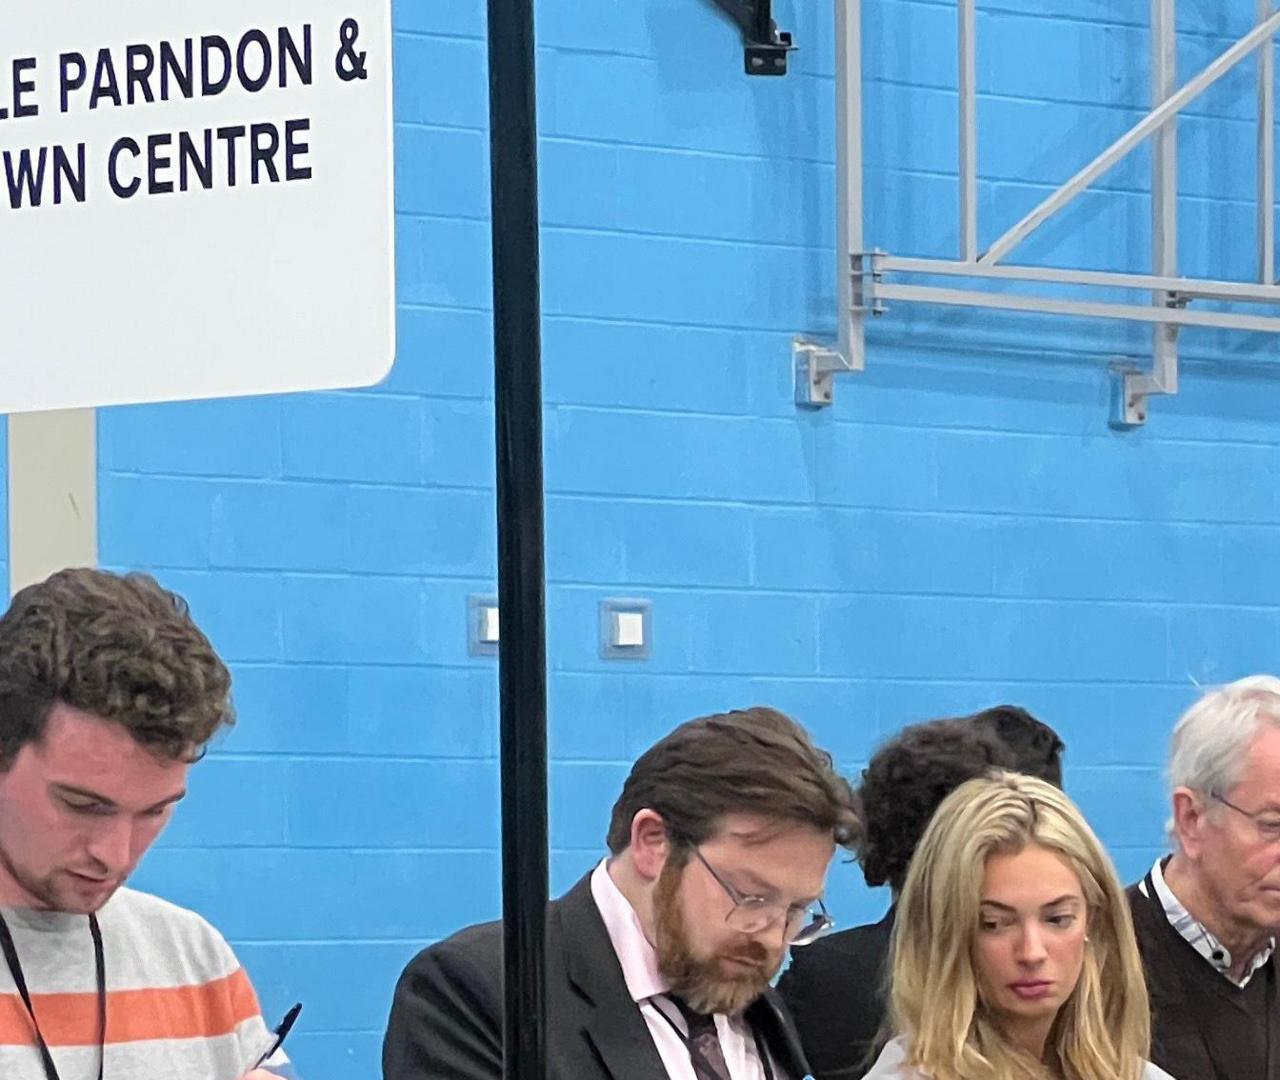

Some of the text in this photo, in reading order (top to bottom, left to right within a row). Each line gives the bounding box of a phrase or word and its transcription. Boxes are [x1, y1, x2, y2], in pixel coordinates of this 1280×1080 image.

[0, 18, 367, 119] E PARNDON &
[3, 119, 312, 208] WN CENTRE
